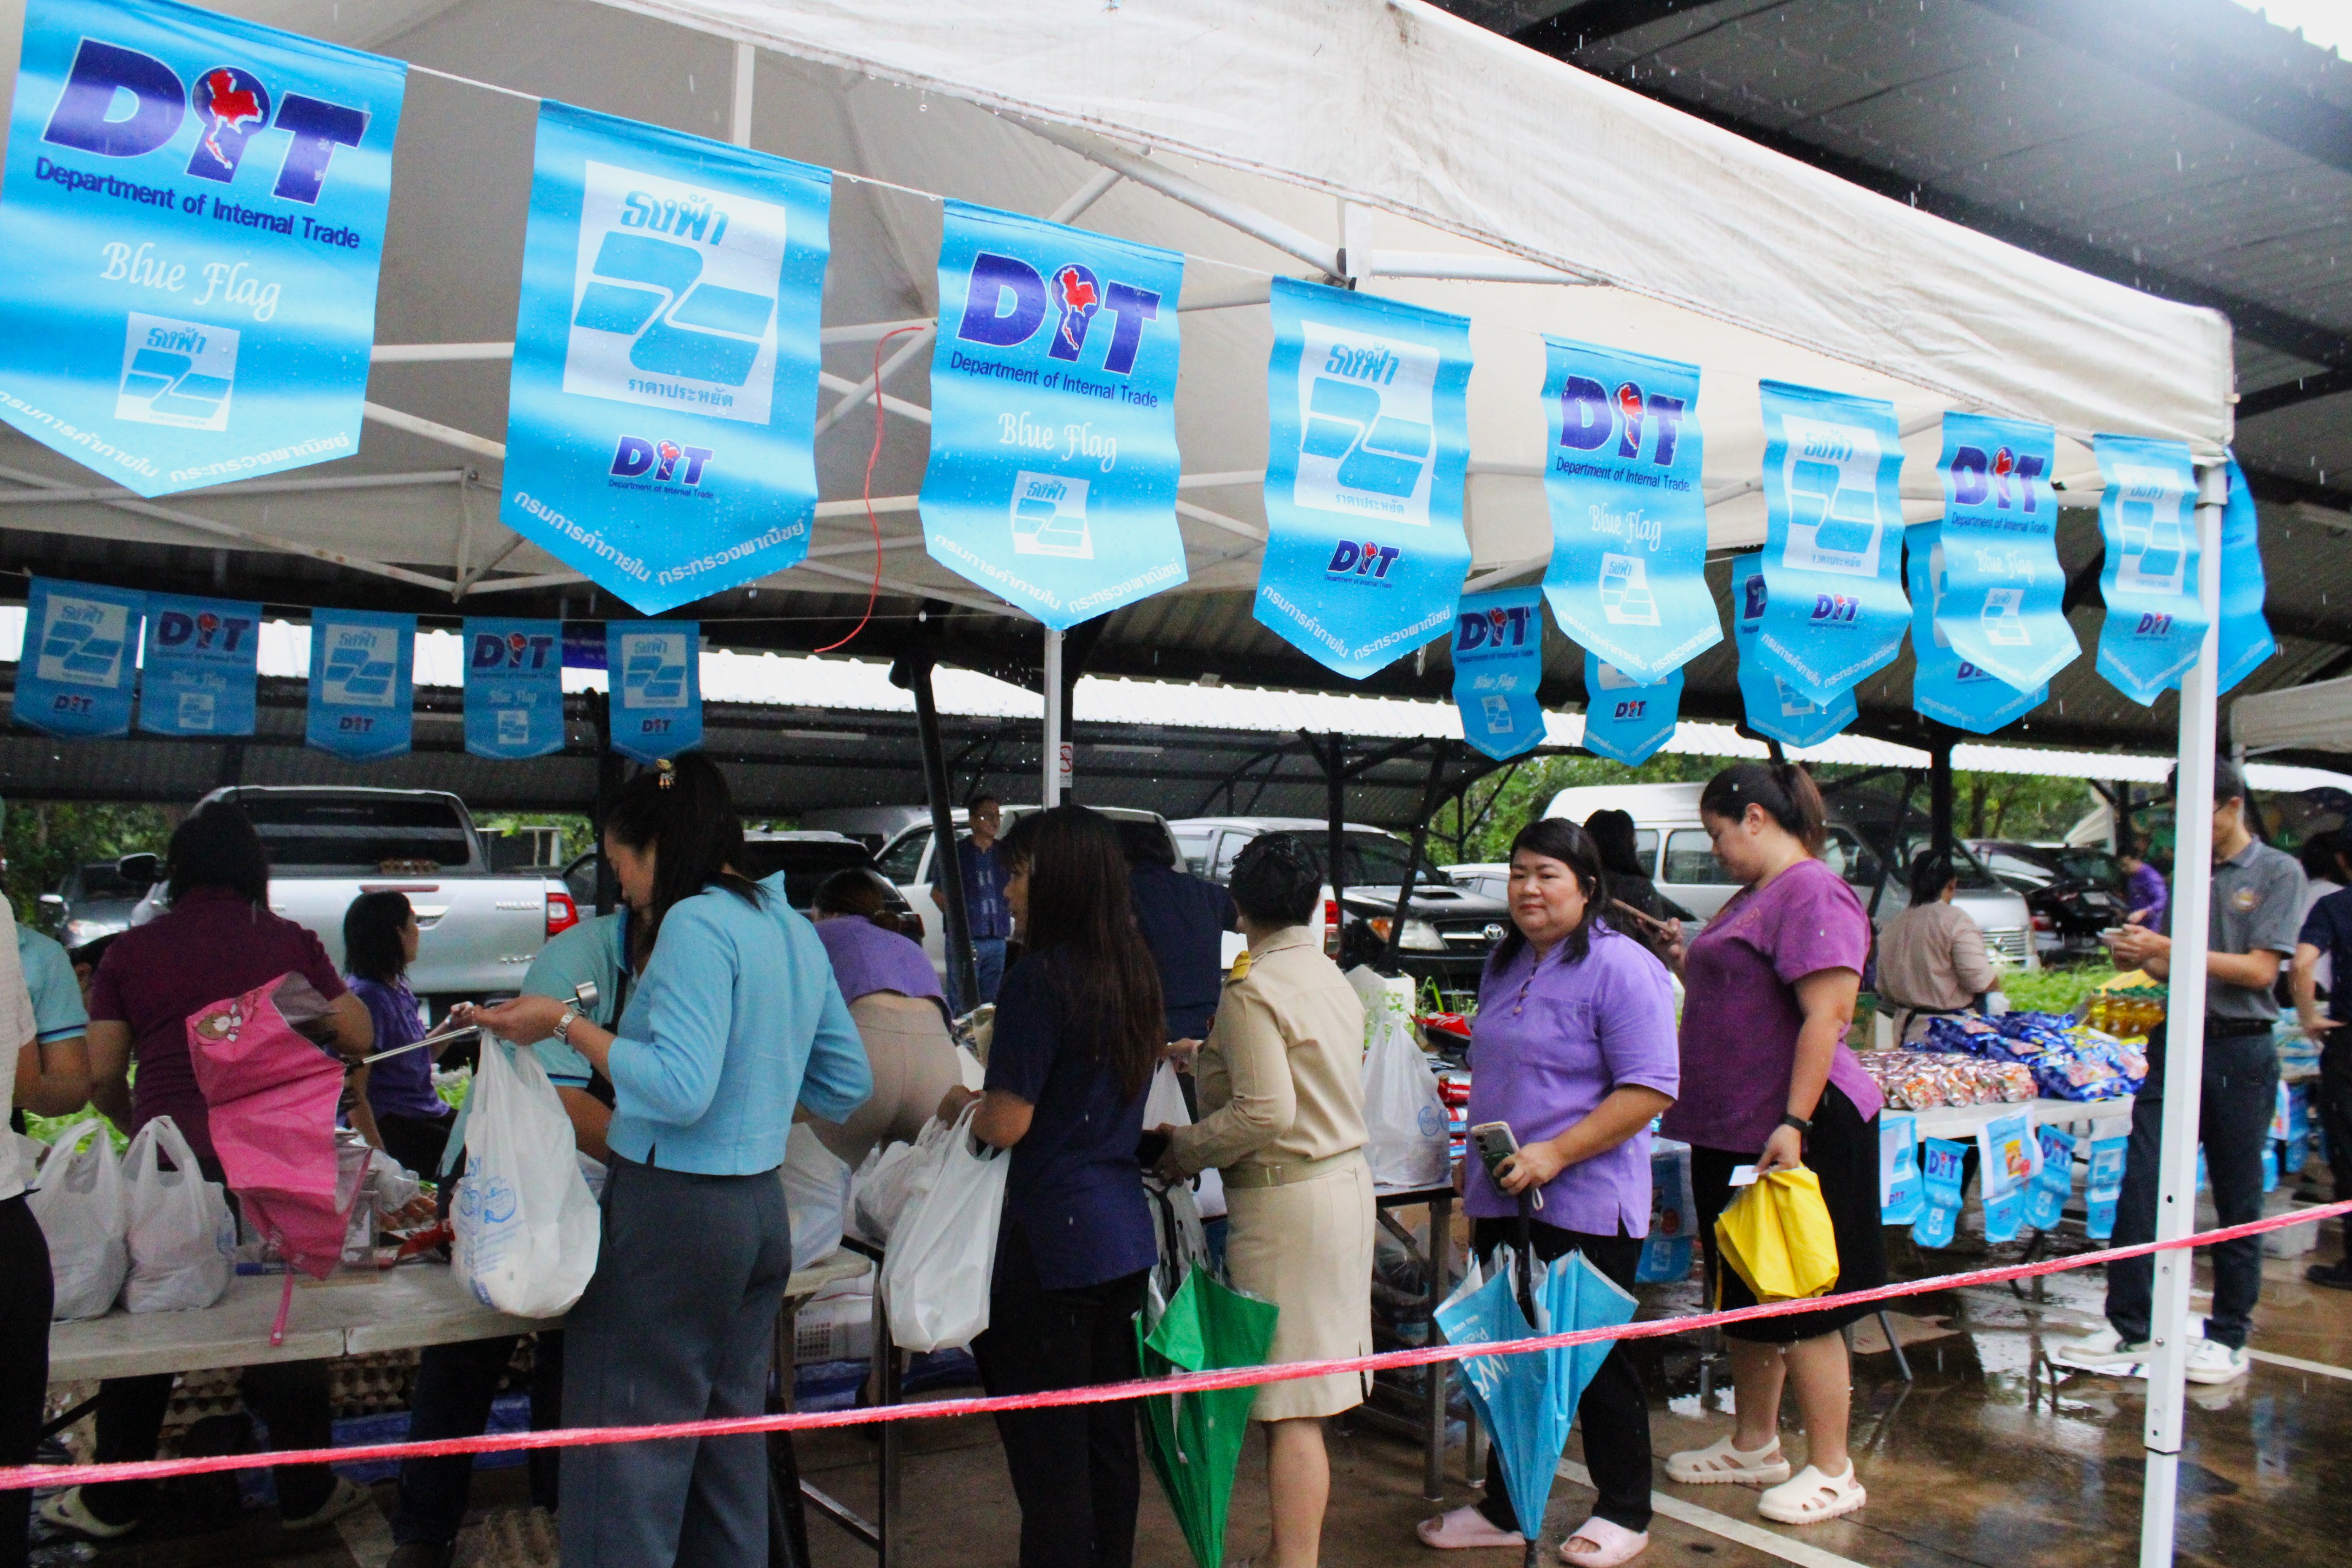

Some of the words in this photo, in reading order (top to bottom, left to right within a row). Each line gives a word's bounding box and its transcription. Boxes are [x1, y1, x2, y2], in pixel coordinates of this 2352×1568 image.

[35, 156, 175, 210] Department
[182, 194, 207, 215] of
[213, 197, 294, 235] Internal
[302, 217, 360, 249] Trade
[620, 190, 730, 247] ธงฟ้า
[99, 241, 187, 292] Blue
[193, 262, 281, 322] Flag
[147, 326, 207, 354] ธงฟ้า
[1325, 341, 1400, 387] ธงฟ้า
[628, 378, 733, 407] ราคาประหยัด
[950, 351, 1040, 386] Department
[1043, 371, 1060, 388] of
[1063, 374, 1116, 401] Internal
[1121, 385, 1159, 408] Trade
[170, 432, 350, 484] กระทรวงพาณิชย์
[997, 412, 1055, 450] Blue
[1061, 422, 1118, 473] Flag
[609, 479, 651, 491] Department
[664, 486, 691, 496] Internal
[694, 489, 714, 499] Trade
[1027, 479, 1067, 501] ธงฟ้า
[1556, 456, 1612, 481] Department
[1614, 468, 1625, 481] of
[1626, 468, 1660, 488] Internal
[1664, 474, 1690, 492] Trade
[1335, 494, 1404, 514] ราคาประหยัด
[1589, 504, 1622, 535] Blue
[1626, 508, 1662, 552] Flag
[1952, 512, 1993, 528] Department
[1995, 517, 2003, 529] of
[2004, 519, 2028, 531] Internal
[515, 489, 652, 583] กรมการค้าภายใน
[657, 520, 806, 587] กระทรวงพาณิชย์
[934, 533, 1061, 612] กรมการค้าภายใน
[1068, 557, 1181, 613] กระทรวงพาณิชย์
[1324, 574, 1353, 583] Department
[1975, 547, 2004, 573] Blue
[2005, 550, 2035, 584] Flag
[1262, 583, 1350, 659] กรมการค้าภายใน
[1354, 605, 1451, 661] กระทรวงพาณิชย์
